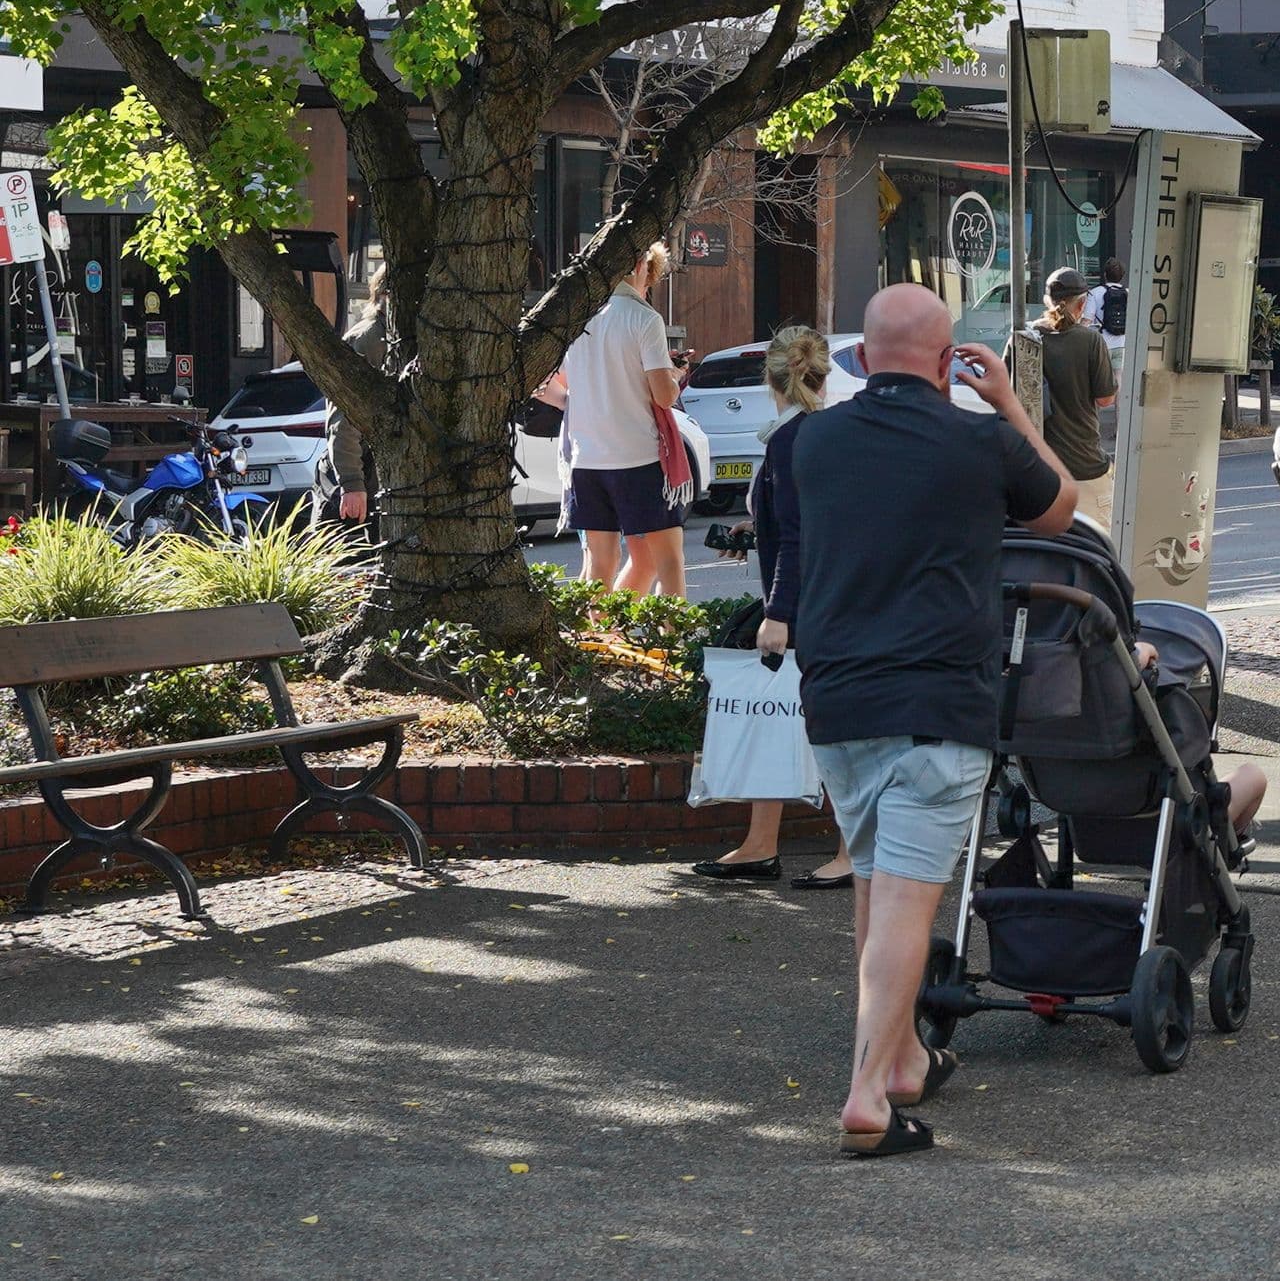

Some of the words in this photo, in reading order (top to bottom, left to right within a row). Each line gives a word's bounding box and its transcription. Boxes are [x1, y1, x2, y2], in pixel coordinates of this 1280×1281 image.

[11, 202, 29, 218] 1P
[1156, 148, 1182, 229] THE
[1147, 254, 1175, 363] SPOT
